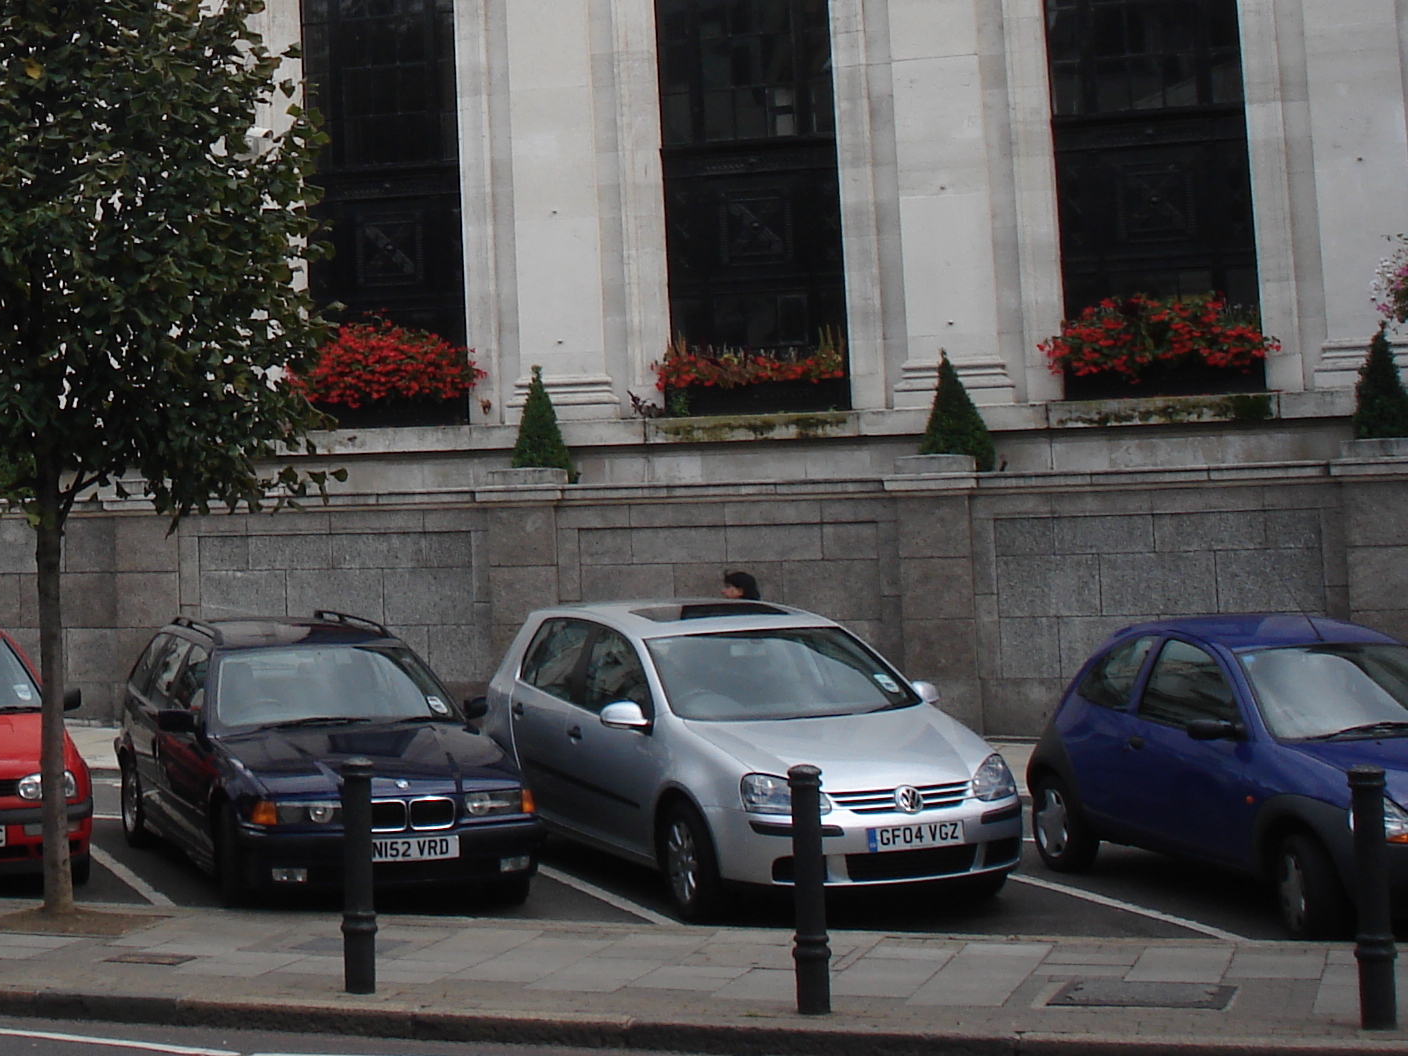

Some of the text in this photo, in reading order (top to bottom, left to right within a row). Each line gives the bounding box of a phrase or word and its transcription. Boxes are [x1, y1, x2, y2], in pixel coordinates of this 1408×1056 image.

[880, 823, 959, 846] GF04 VGZ
[373, 838, 450, 859] N152 VRD
